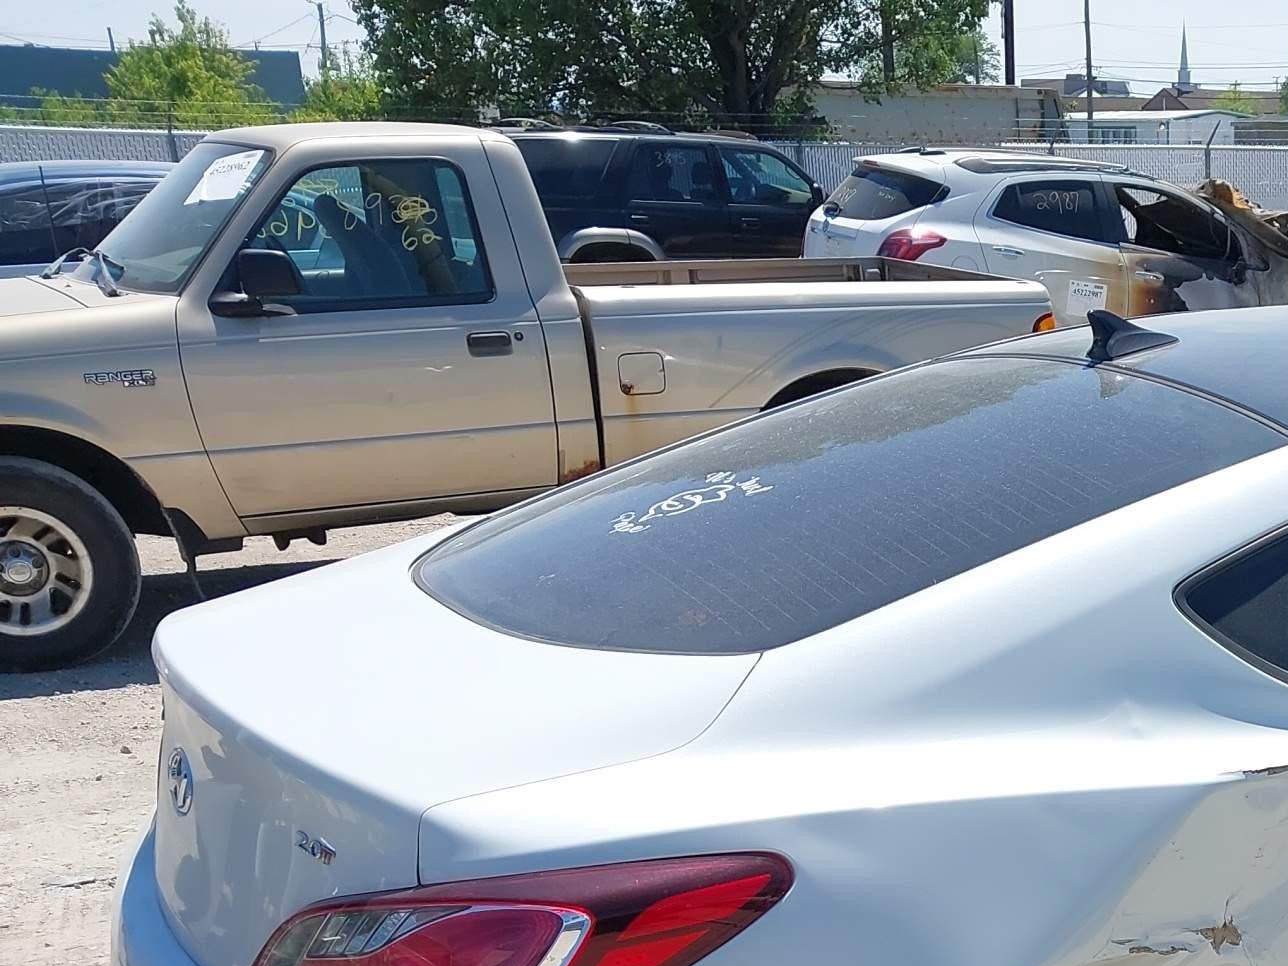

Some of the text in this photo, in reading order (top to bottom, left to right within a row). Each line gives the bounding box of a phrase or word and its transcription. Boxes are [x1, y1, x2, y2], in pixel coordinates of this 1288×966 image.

[1032, 191, 1079, 214] 2987
[402, 225, 444, 251] 62
[83, 369, 157, 386] RANGER
